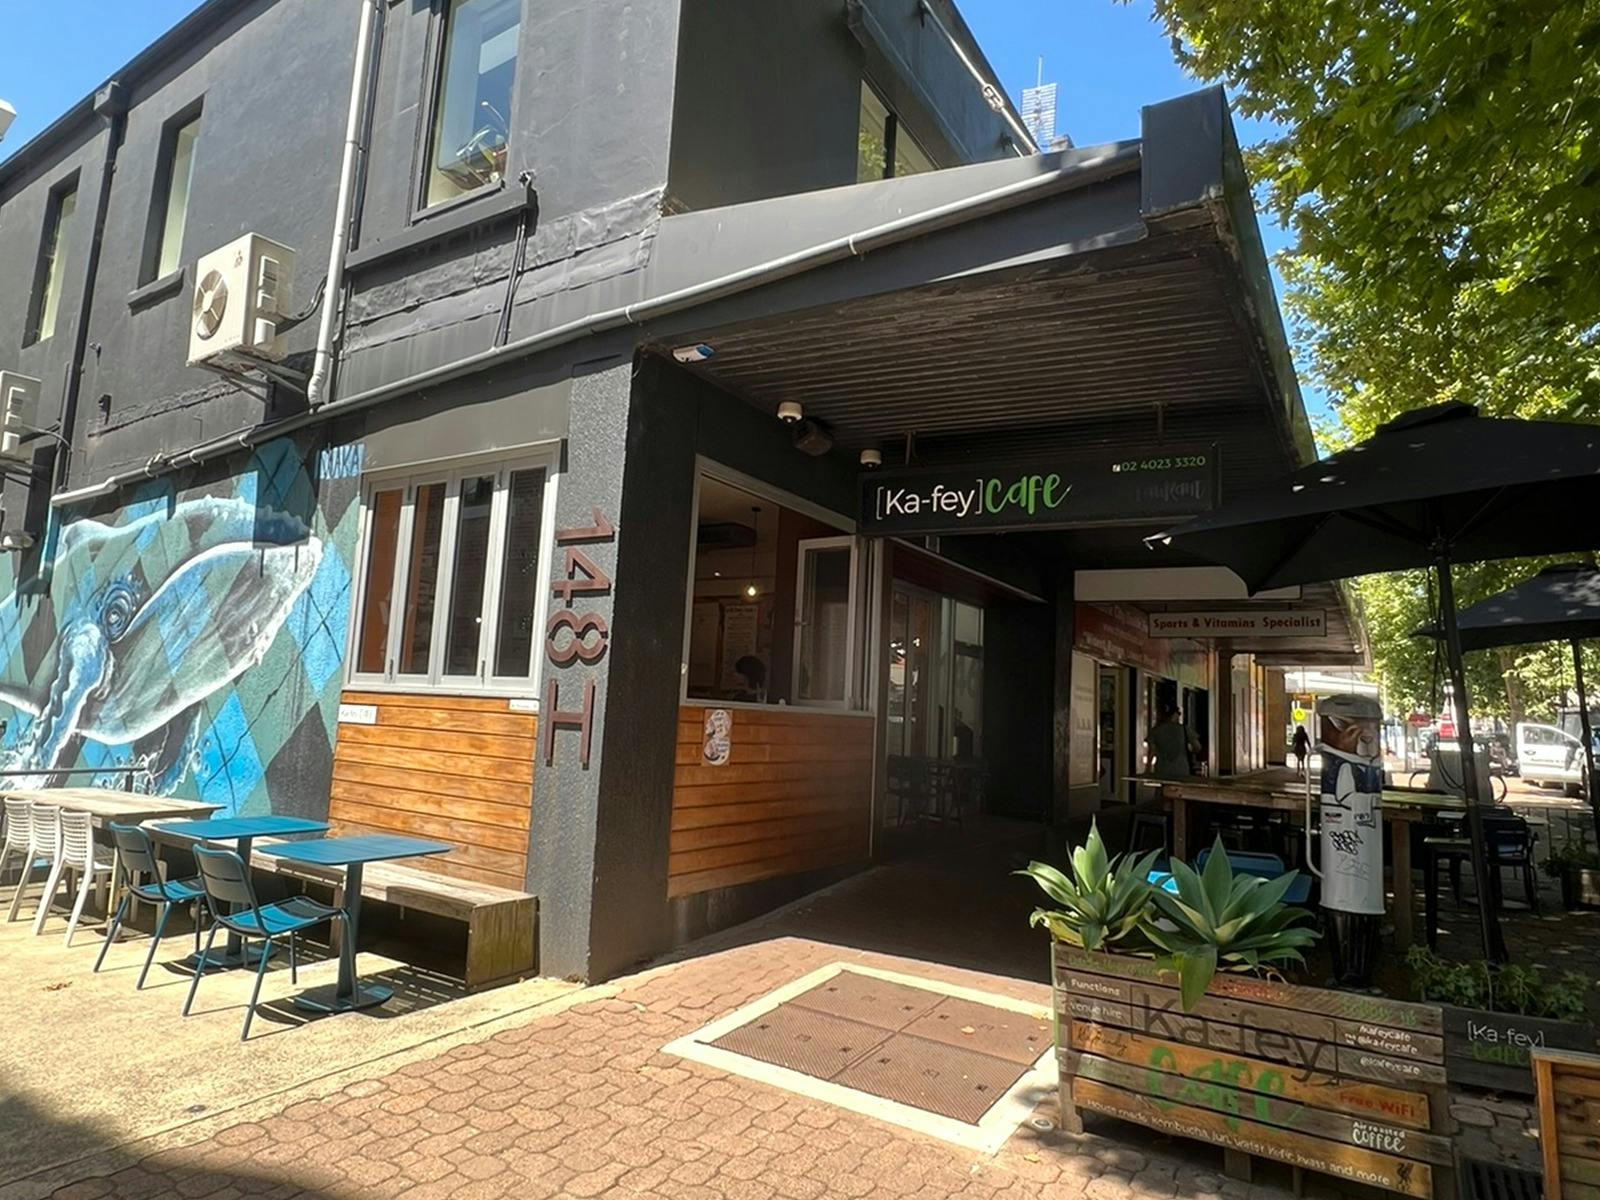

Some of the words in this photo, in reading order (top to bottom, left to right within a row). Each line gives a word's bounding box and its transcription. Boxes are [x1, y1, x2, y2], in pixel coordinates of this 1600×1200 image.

[1121, 461, 1137, 471] 02
[1140, 459, 1171, 470] 4023
[1175, 456, 1206, 468] 3320
[876, 479, 983, 520] [Ka-fey]
[1153, 618, 1188, 630] Sports
[1192, 618, 1200, 628] &
[1204, 617, 1255, 628] Vitamins
[1262, 616, 1320, 629] Specialist
[1071, 978, 1120, 996] Functions
[1330, 1164, 1353, 1176] and
[1357, 1172, 1390, 1186] more
